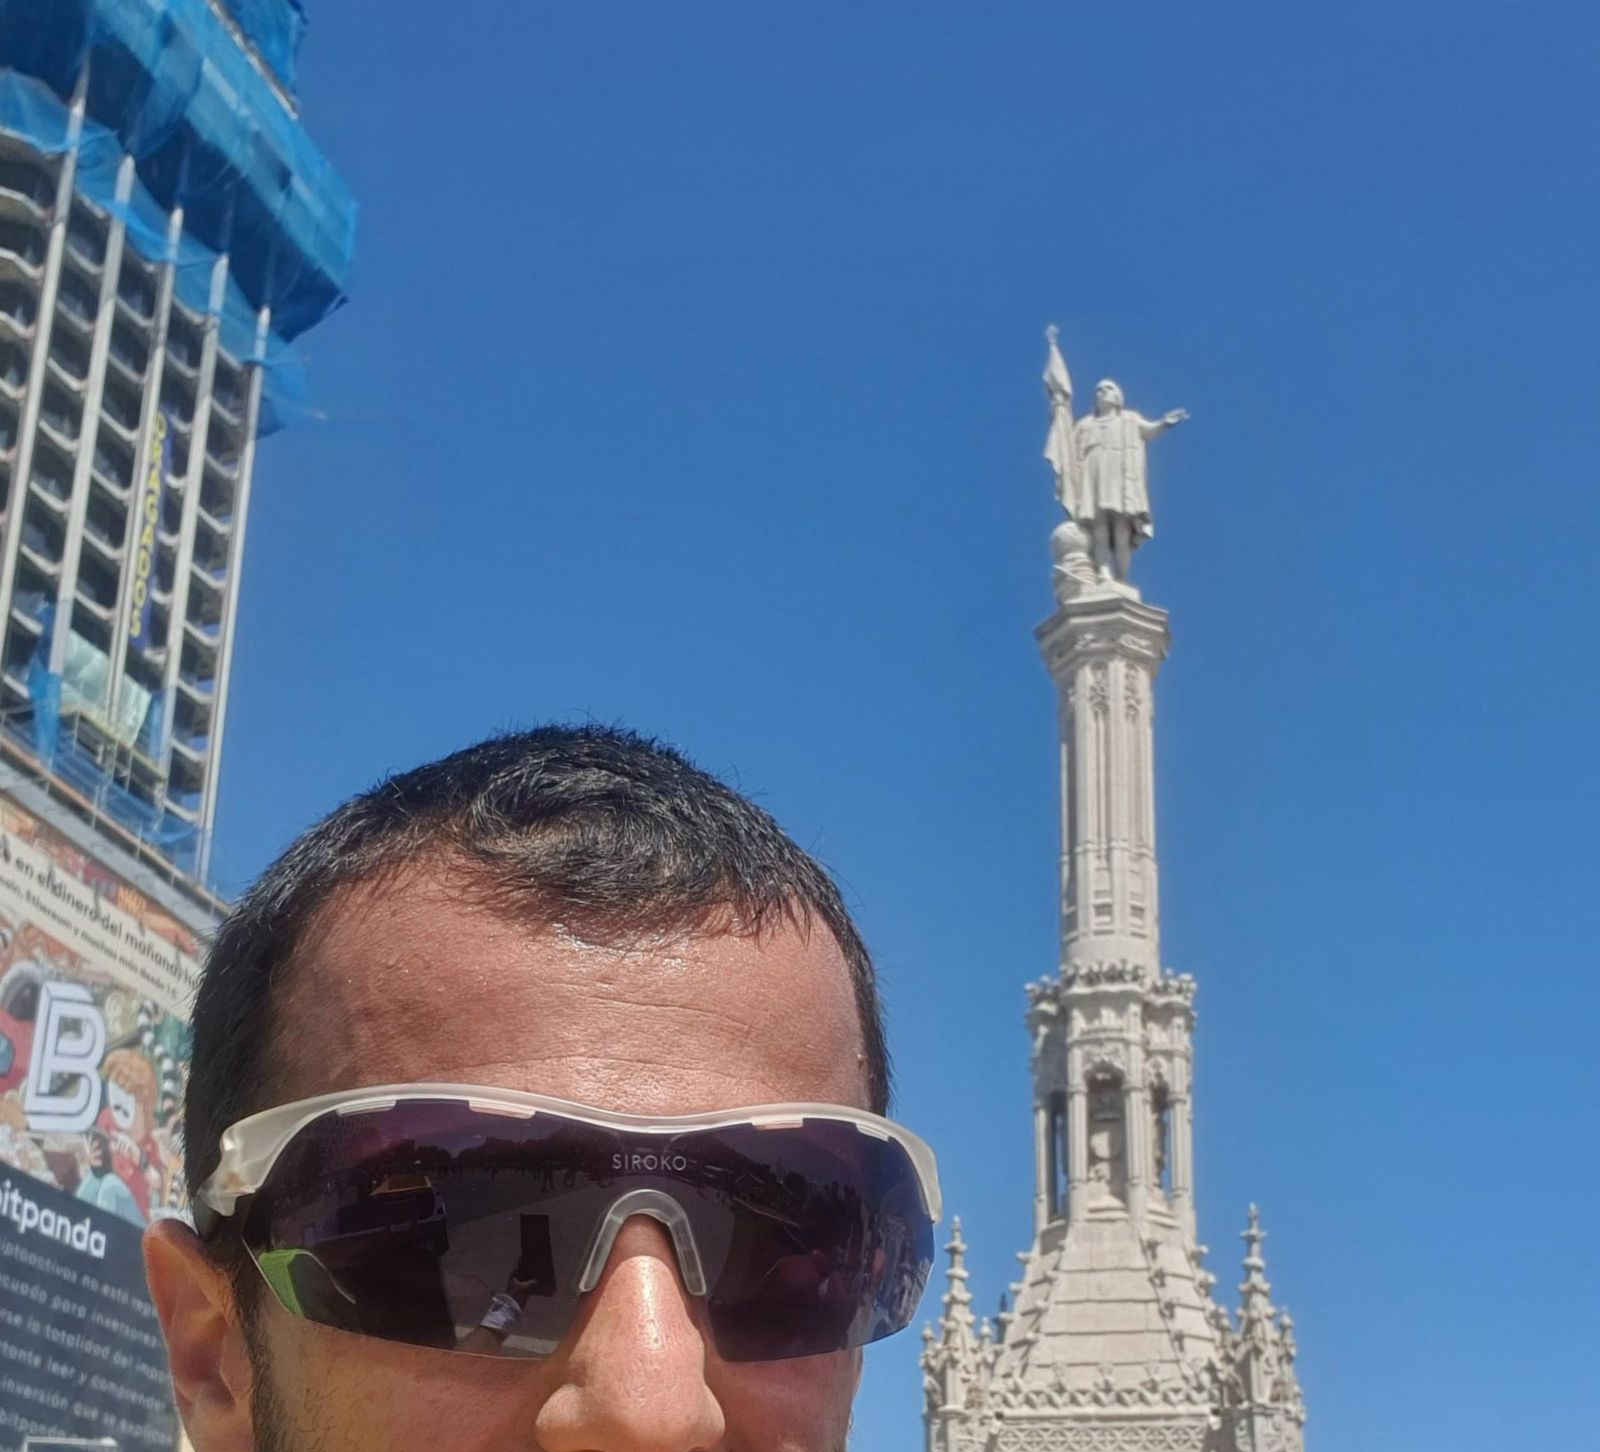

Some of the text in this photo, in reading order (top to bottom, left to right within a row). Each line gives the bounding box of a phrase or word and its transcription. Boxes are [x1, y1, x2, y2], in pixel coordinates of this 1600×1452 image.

[16, 857, 34, 880] en
[51, 879, 100, 922] dinero
[101, 911, 123, 939] del
[611, 1153, 687, 1171] SIROKO
[0, 1178, 106, 1260] itpanda
[45, 1323, 111, 1361] totalidad
